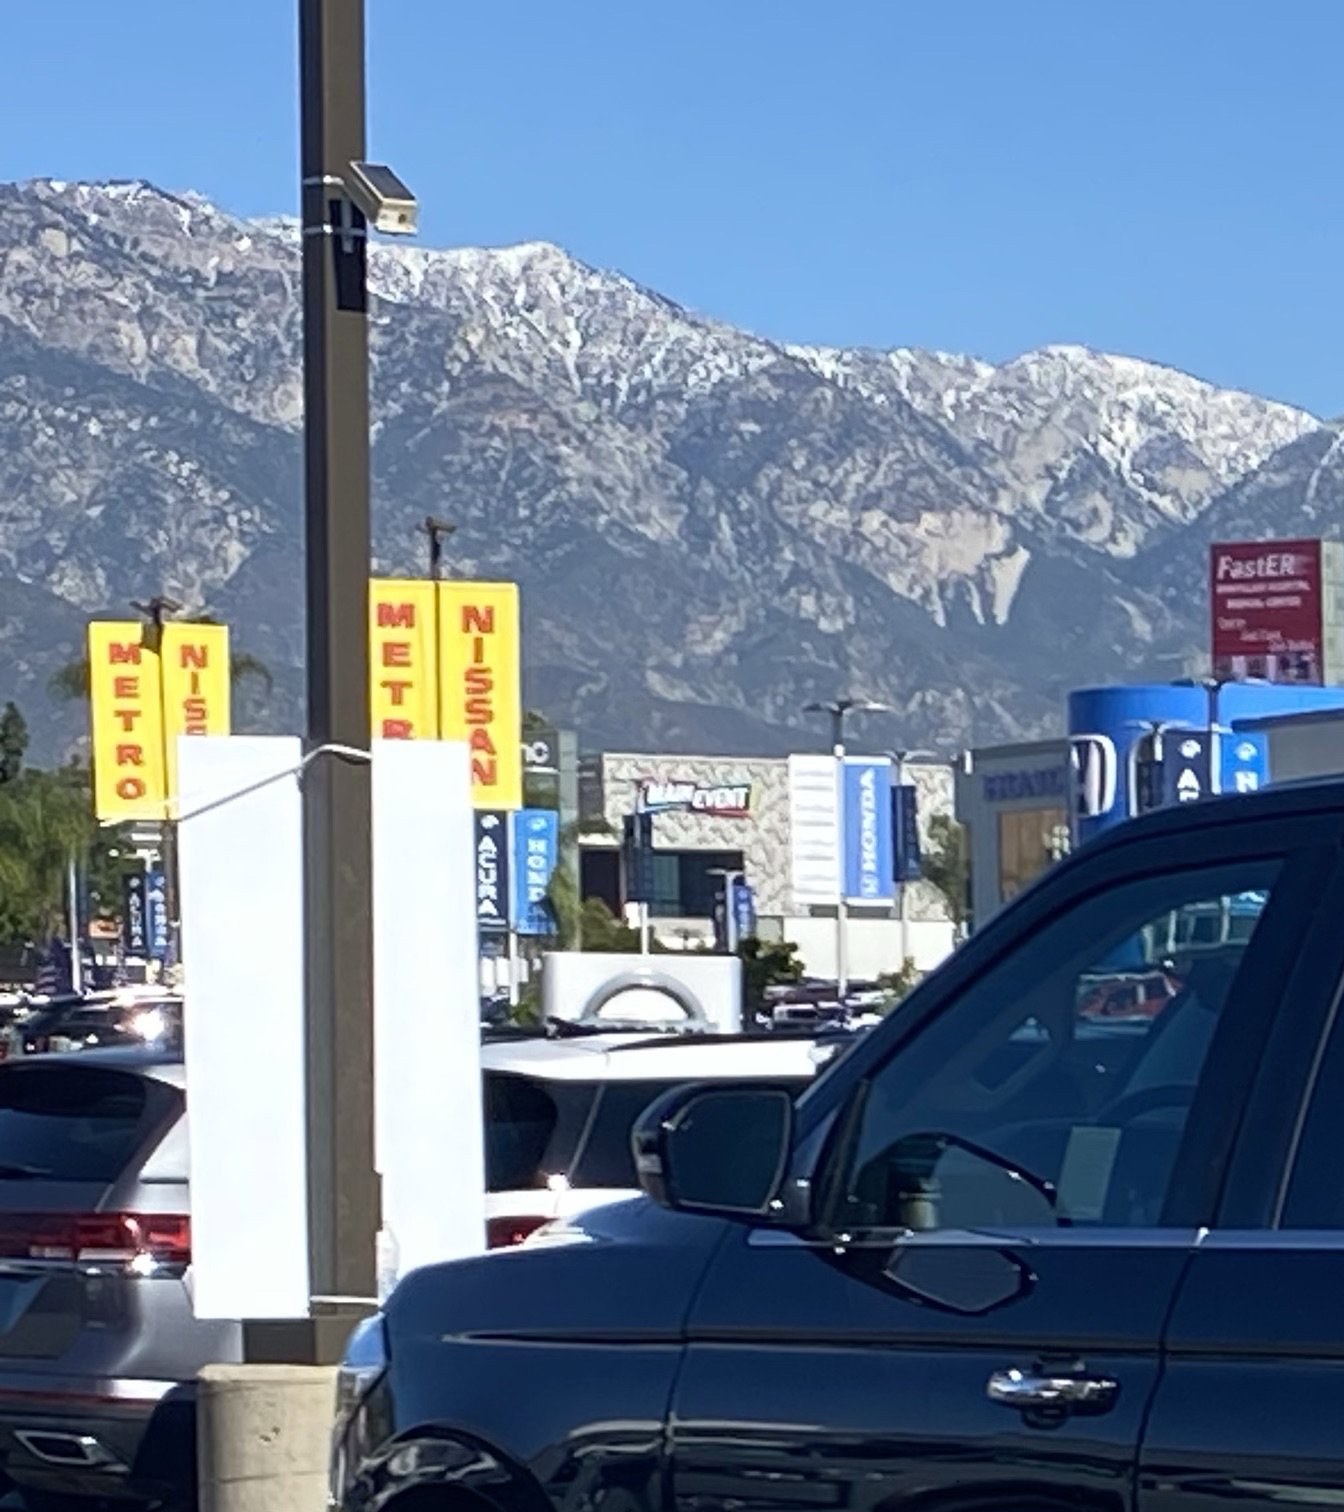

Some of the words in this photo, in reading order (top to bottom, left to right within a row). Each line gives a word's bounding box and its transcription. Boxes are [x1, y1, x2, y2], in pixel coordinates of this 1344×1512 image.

[1217, 554, 1295, 579] FastER
[109, 642, 147, 800] METRO
[377, 603, 415, 740] METR
[462, 606, 498, 786] NISSAN
[478, 835, 498, 915] ACURA
